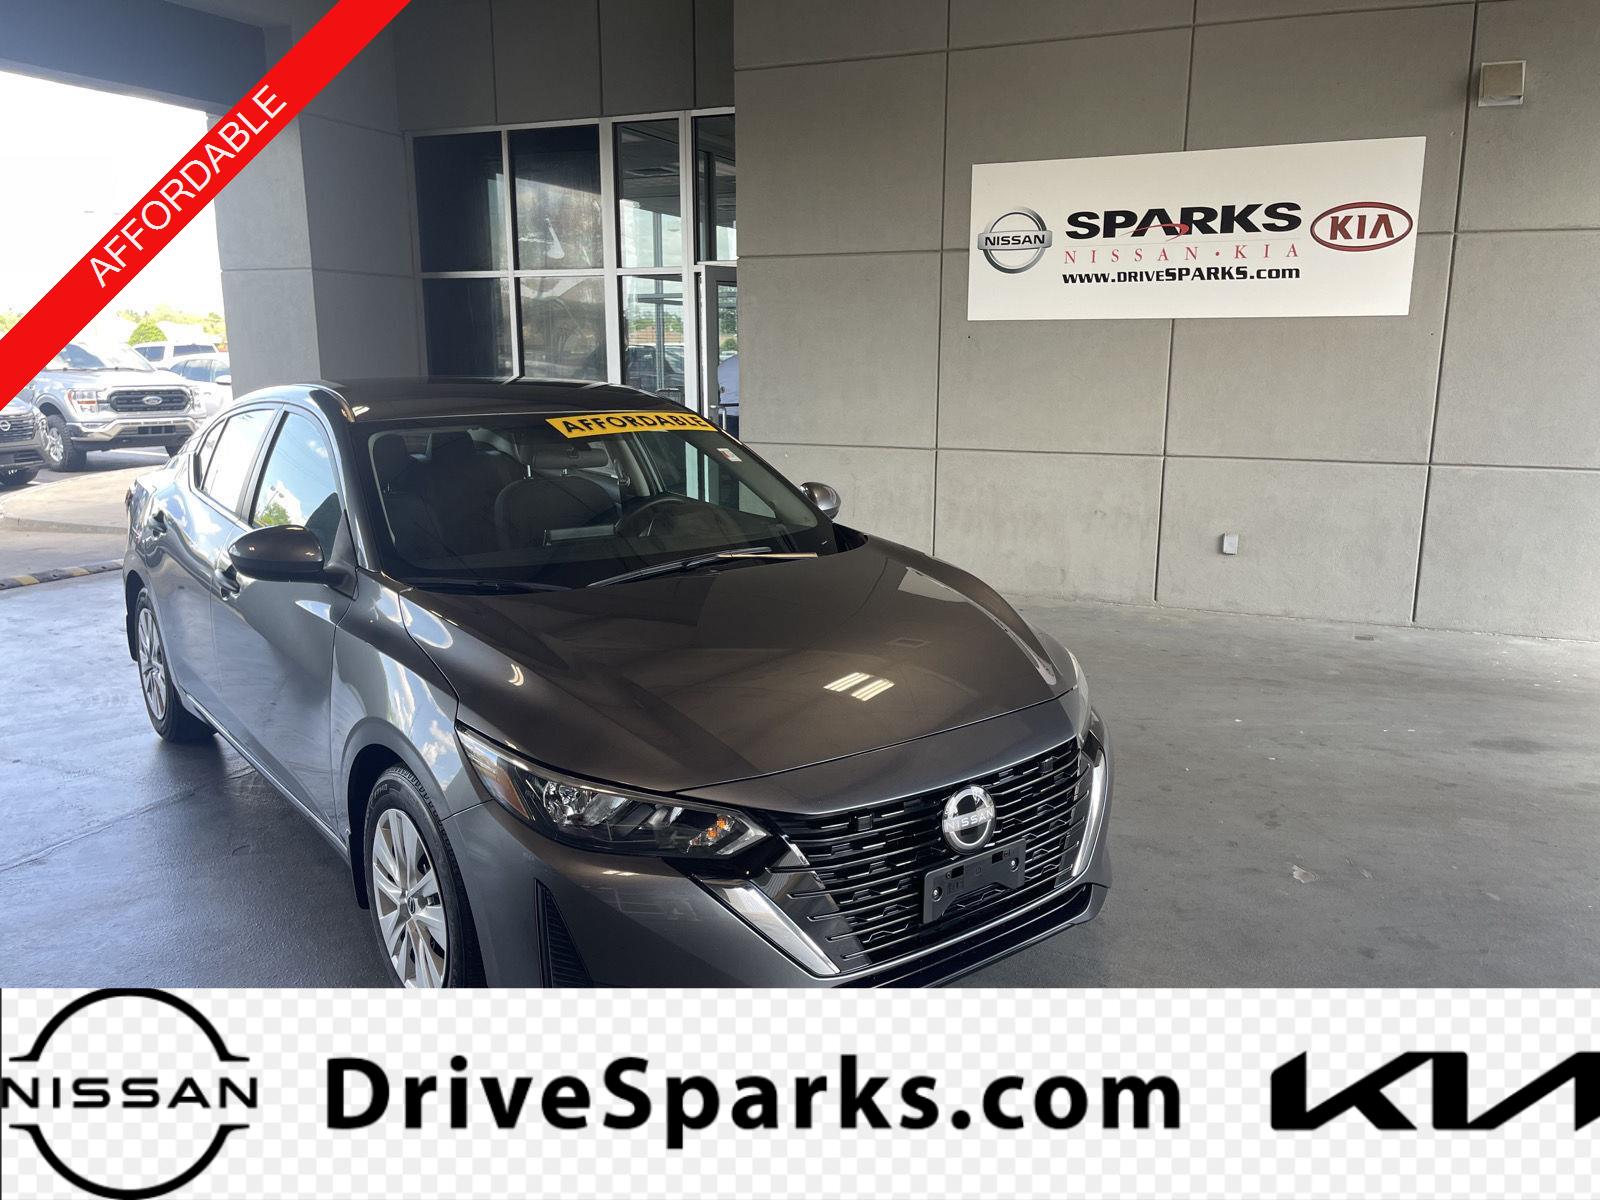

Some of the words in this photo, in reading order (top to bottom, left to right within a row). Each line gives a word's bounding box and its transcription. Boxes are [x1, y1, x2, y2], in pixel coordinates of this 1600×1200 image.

[1065, 202, 1301, 241] SPARKS
[1329, 214, 1395, 241] KIA
[985, 235, 1046, 246] NISSAN
[562, 415, 709, 433] AFFORDABLE
[945, 810, 994, 830] NISSAN
